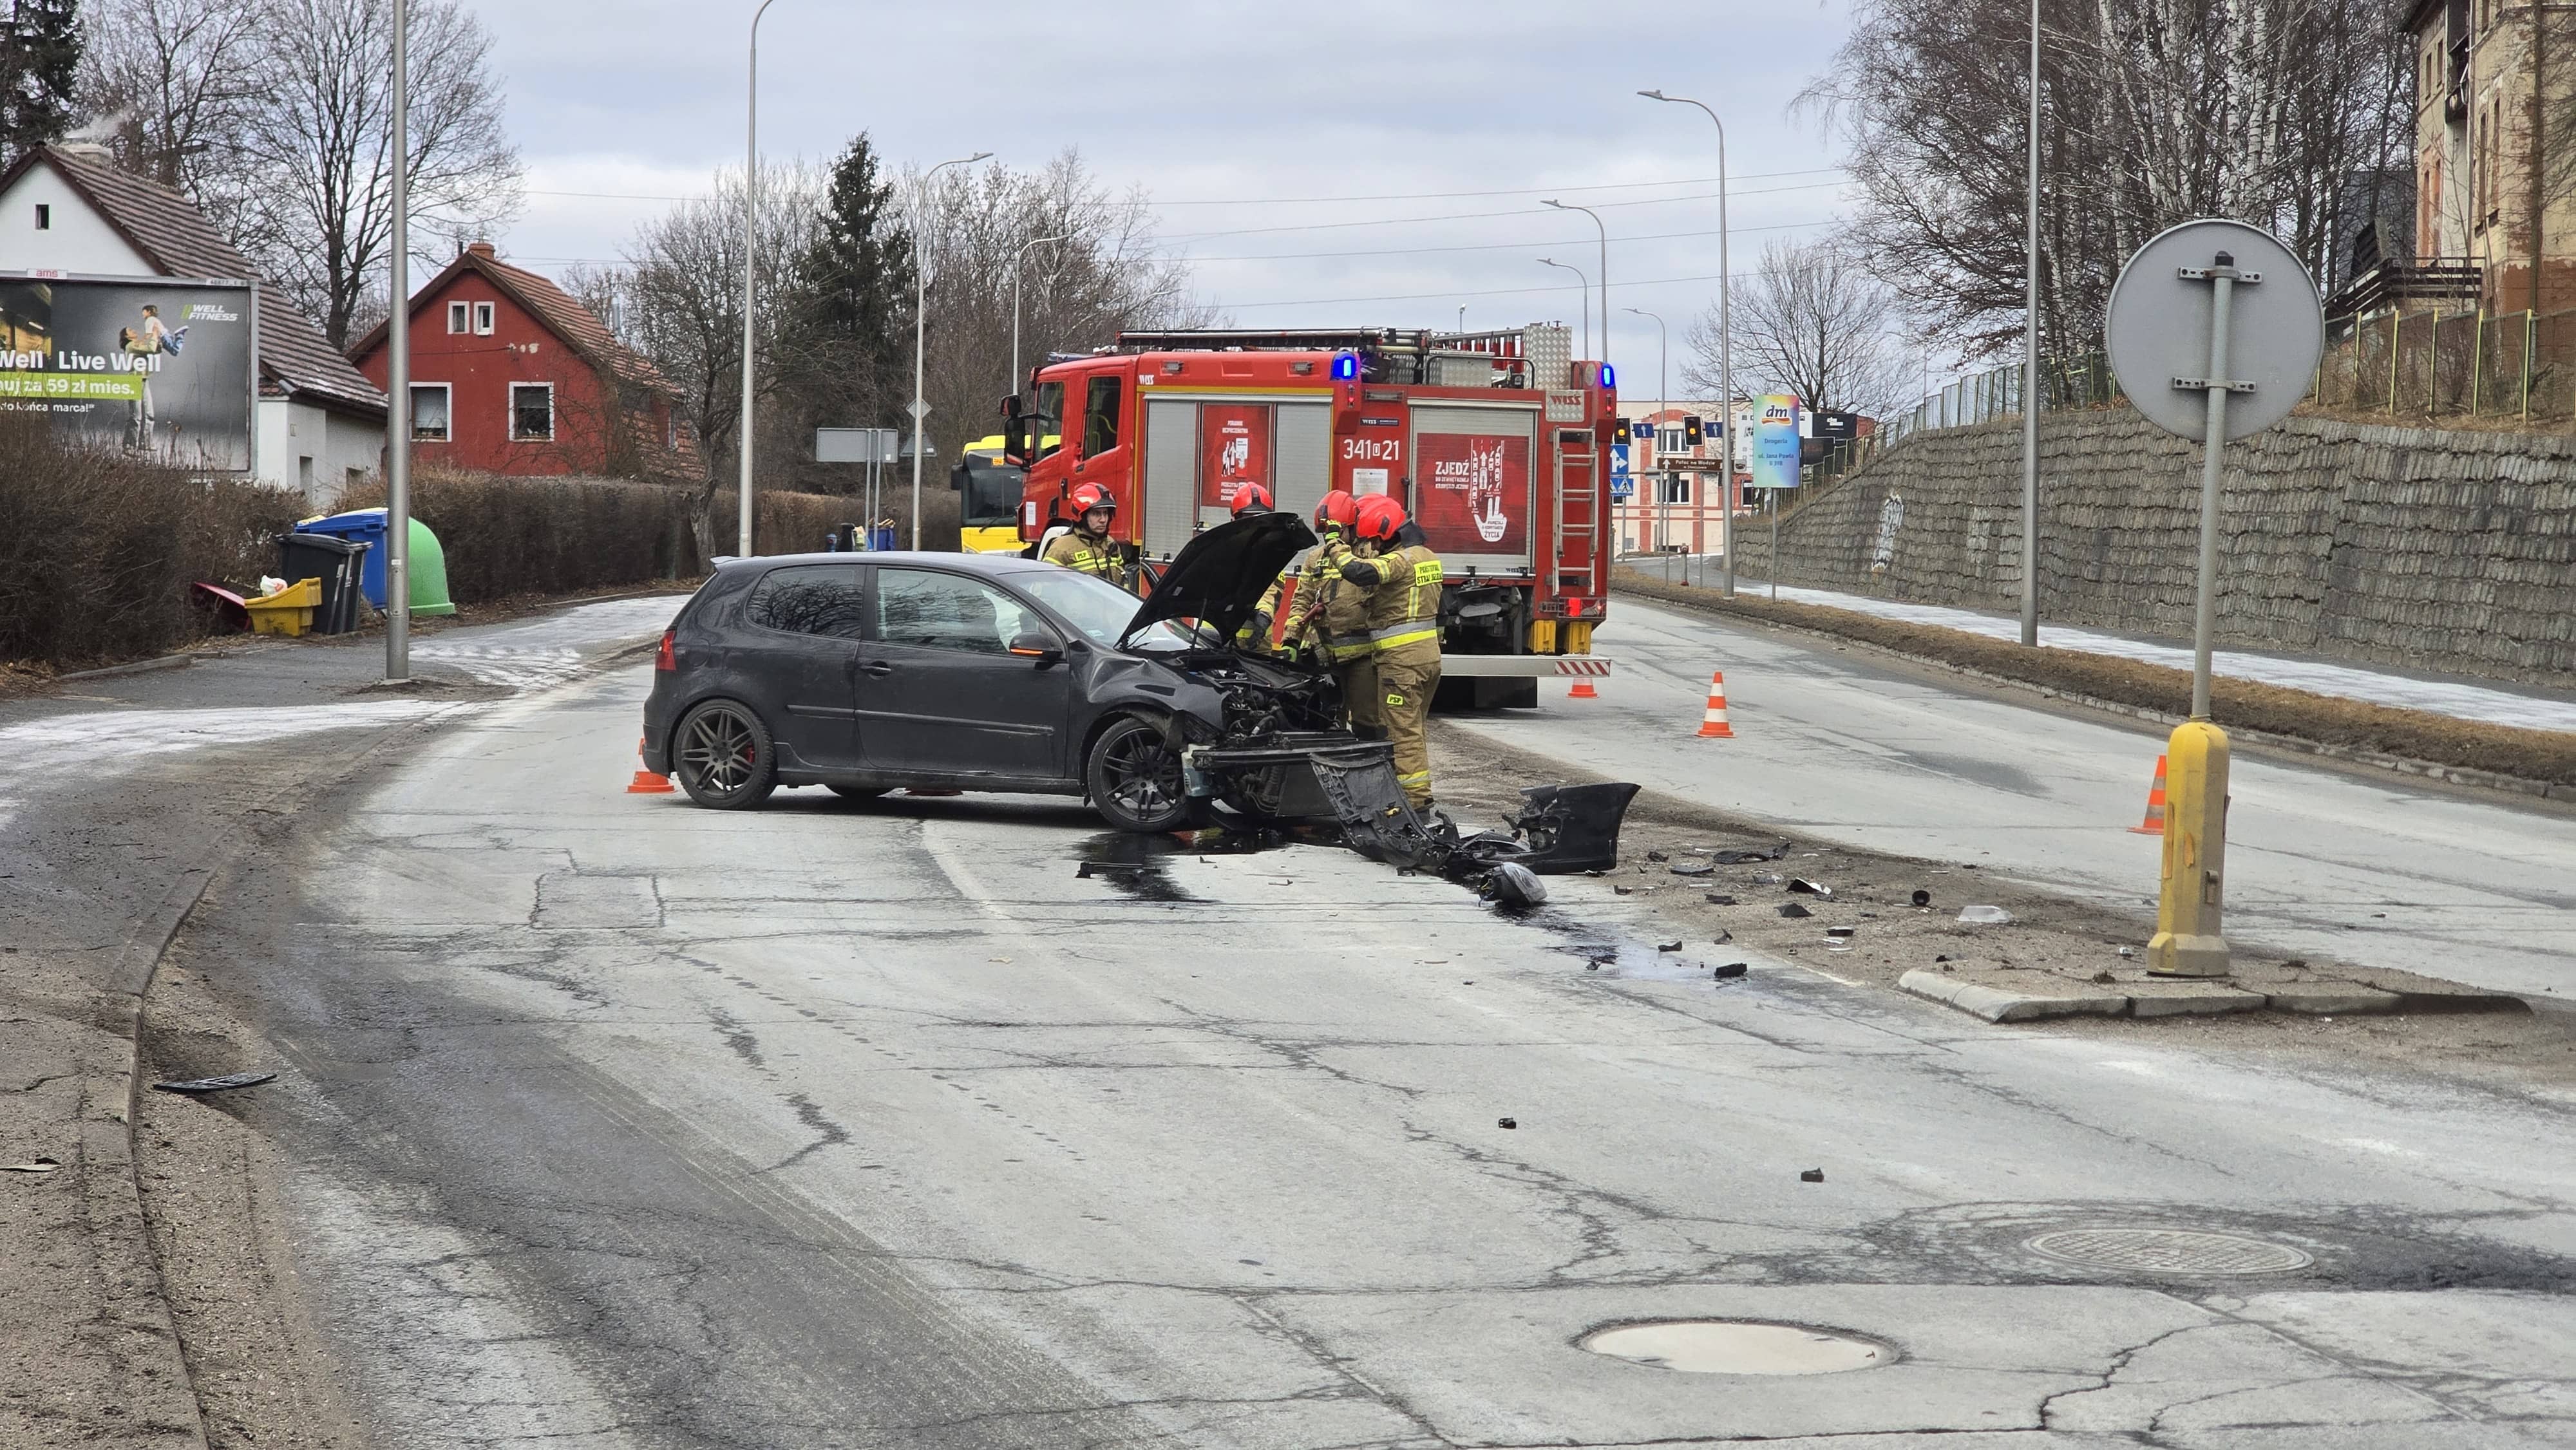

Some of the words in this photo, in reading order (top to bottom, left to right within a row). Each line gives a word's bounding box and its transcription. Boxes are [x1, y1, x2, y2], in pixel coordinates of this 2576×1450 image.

[36, 269, 58, 278] ams
[193, 304, 225, 313] WELL
[189, 312, 238, 321] FITNESS
[59, 350, 106, 370] Live
[110, 352, 160, 372] Well
[46, 379, 68, 393] 59
[71, 379, 86, 393] zł
[90, 380, 135, 395] mies.
[1550, 395, 1581, 406] WISS
[1766, 405, 1787, 418] dm
[1435, 459, 1469, 476] ZJEDŹ
